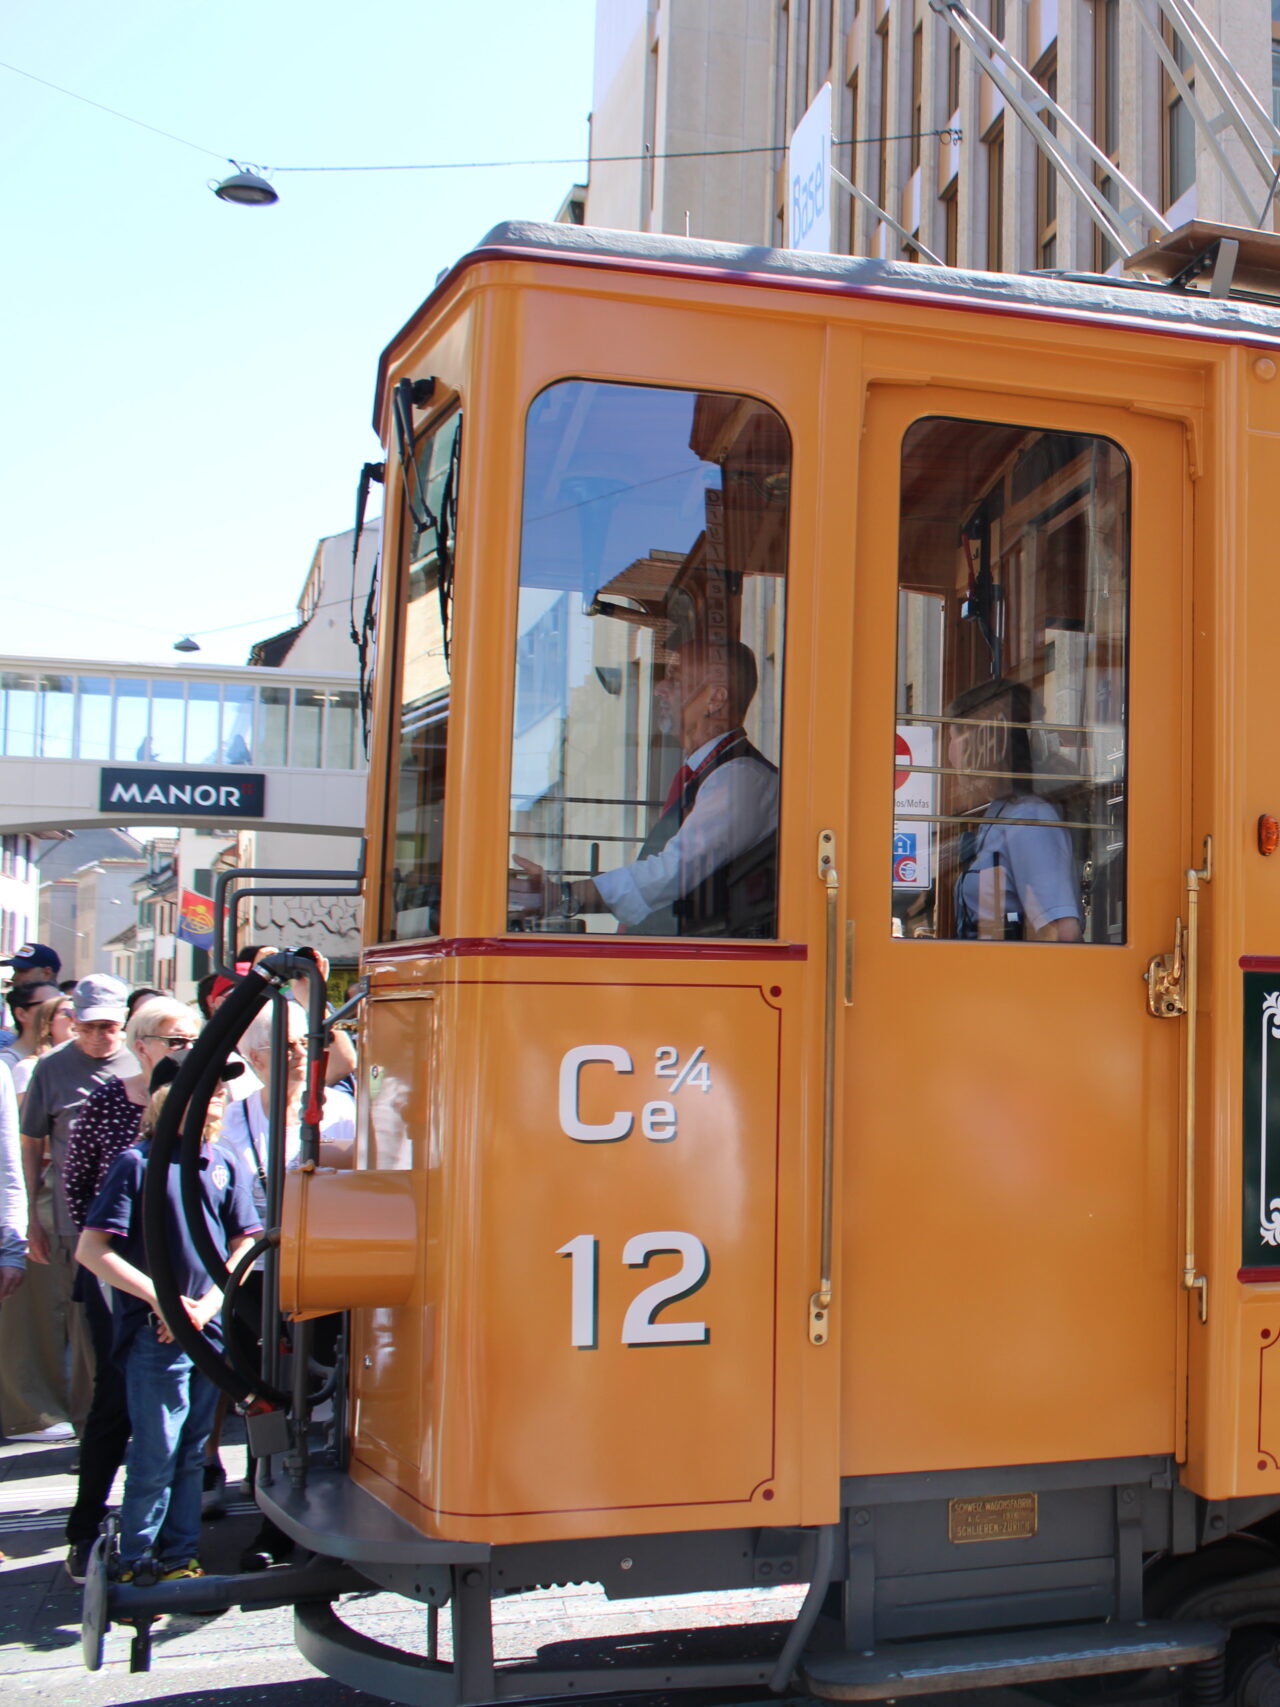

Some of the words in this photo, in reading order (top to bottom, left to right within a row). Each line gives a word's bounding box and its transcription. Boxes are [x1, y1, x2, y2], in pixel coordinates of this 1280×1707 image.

[793, 135, 825, 250] Basel
[109, 782, 241, 807] MANOR
[555, 1230, 711, 1350] 12
